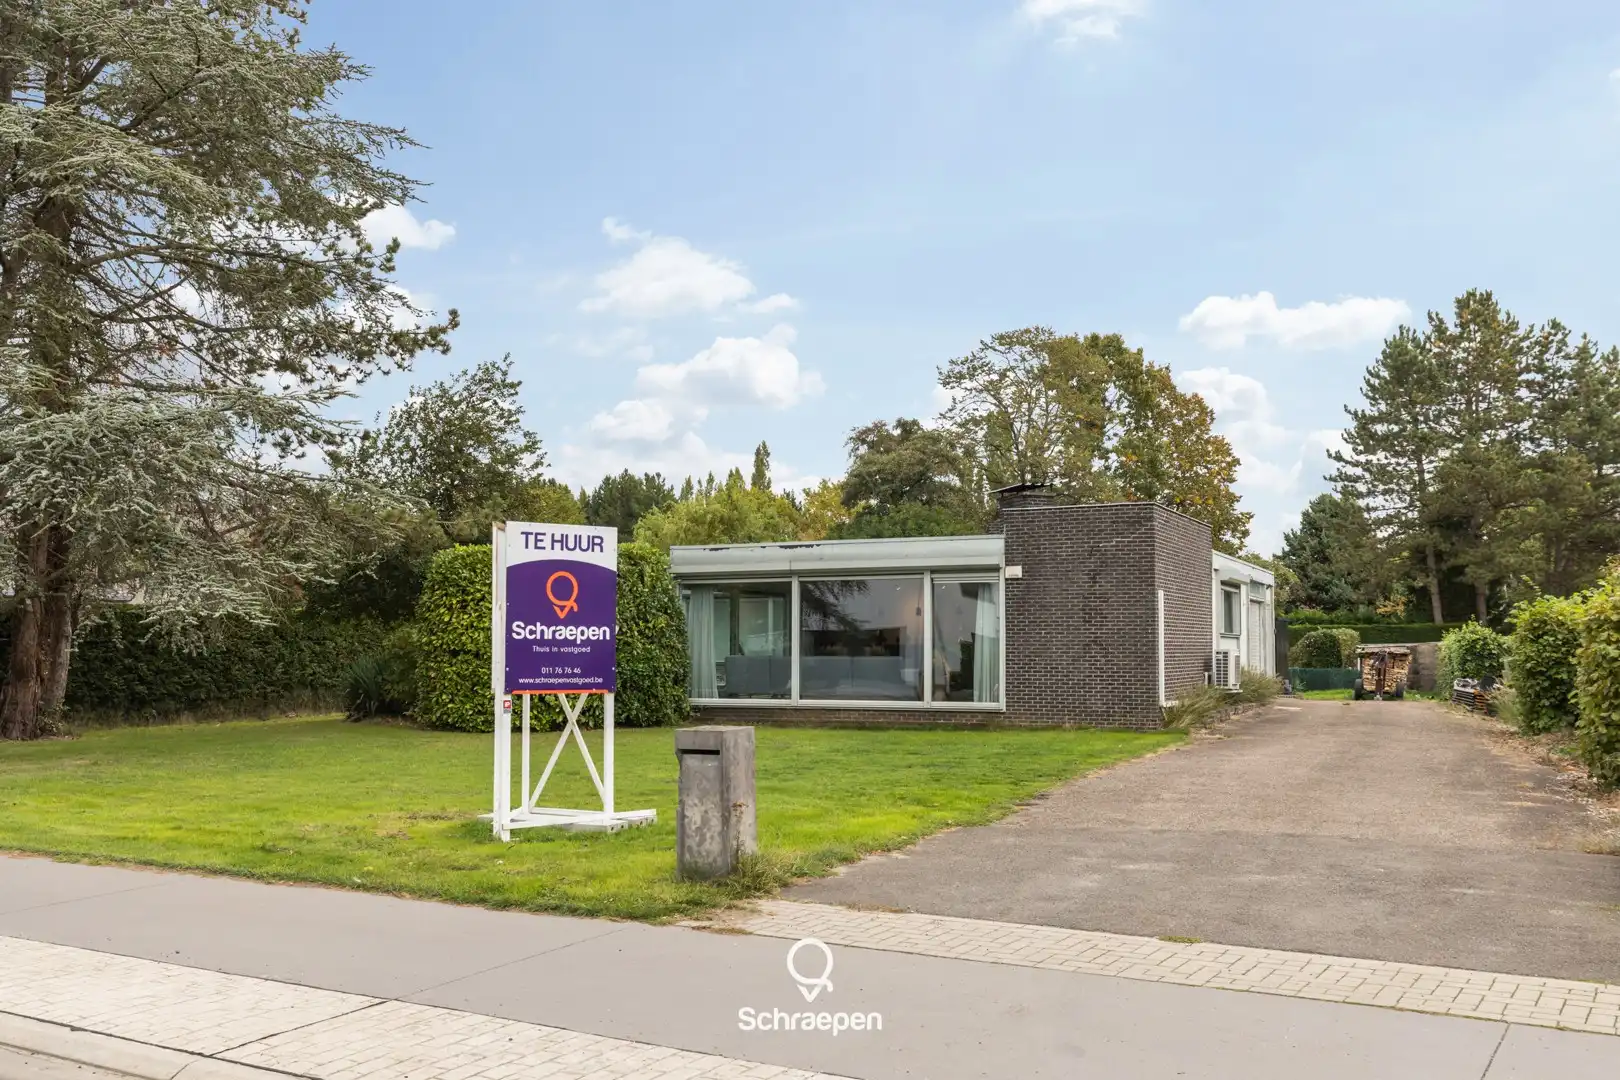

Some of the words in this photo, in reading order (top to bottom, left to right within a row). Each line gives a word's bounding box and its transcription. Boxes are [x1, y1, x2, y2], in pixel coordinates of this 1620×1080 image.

[520, 531, 546, 550] TE
[551, 533, 604, 553] HUUR
[511, 621, 610, 644] Schraepen
[560, 646, 591, 654] vastgoed
[518, 676, 603, 685] www.schraepenvastgoed.be
